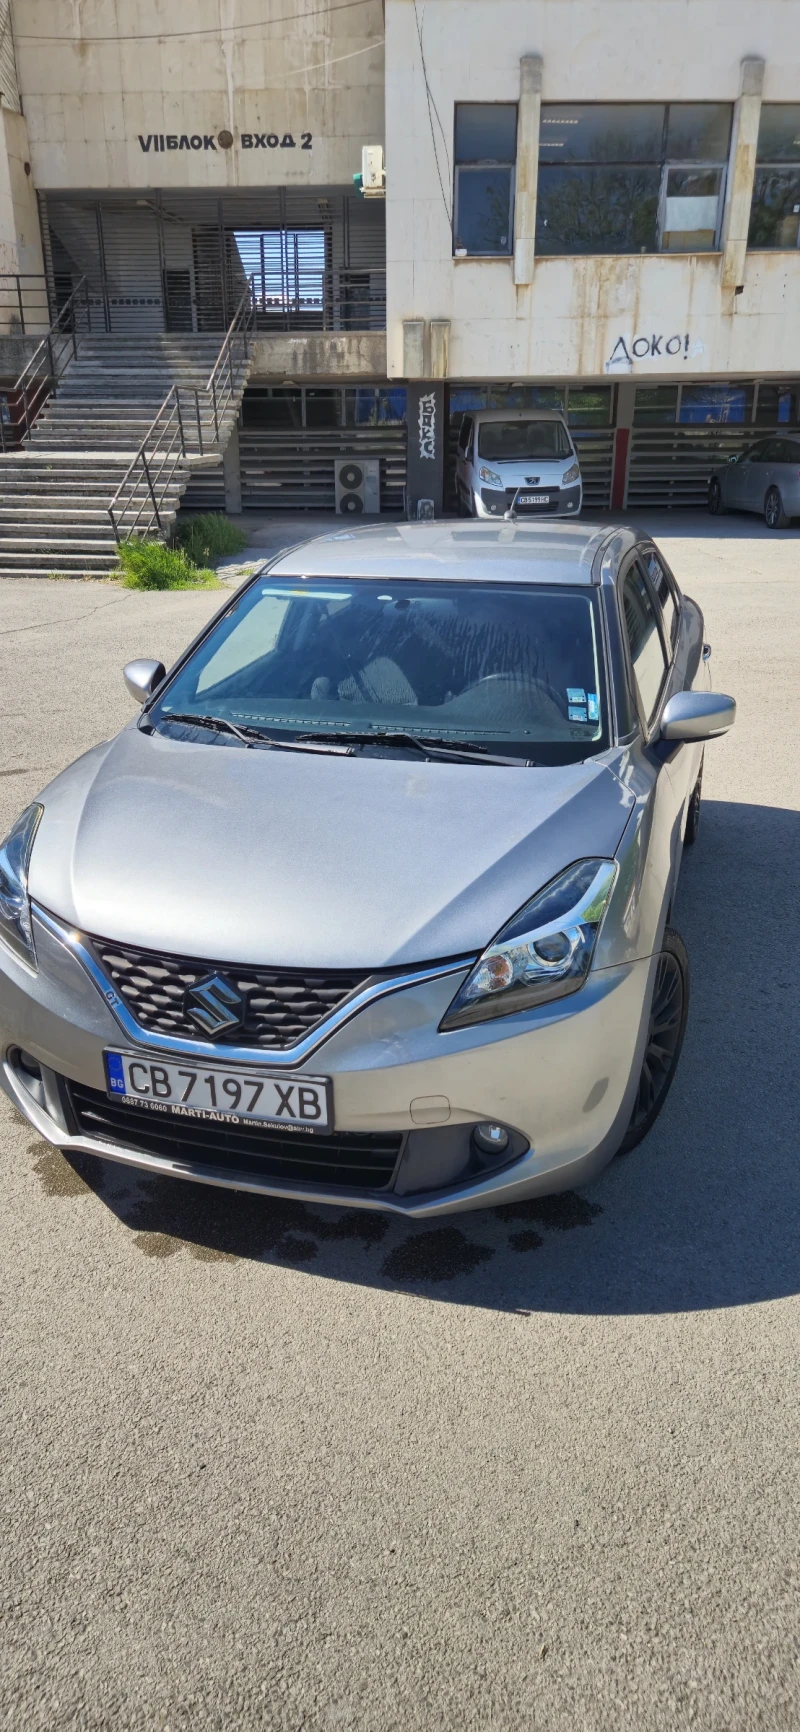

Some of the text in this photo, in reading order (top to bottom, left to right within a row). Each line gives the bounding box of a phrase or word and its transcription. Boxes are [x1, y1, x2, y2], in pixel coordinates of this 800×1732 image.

[241, 134, 296, 149] ВХОД
[301, 133, 313, 150] 2
[105, 991, 120, 1006] GT
[110, 1077, 124, 1088] BG
[128, 1062, 322, 1120] CB 7197 XB
[171, 1105, 240, 1124] MARTI-AUTO
